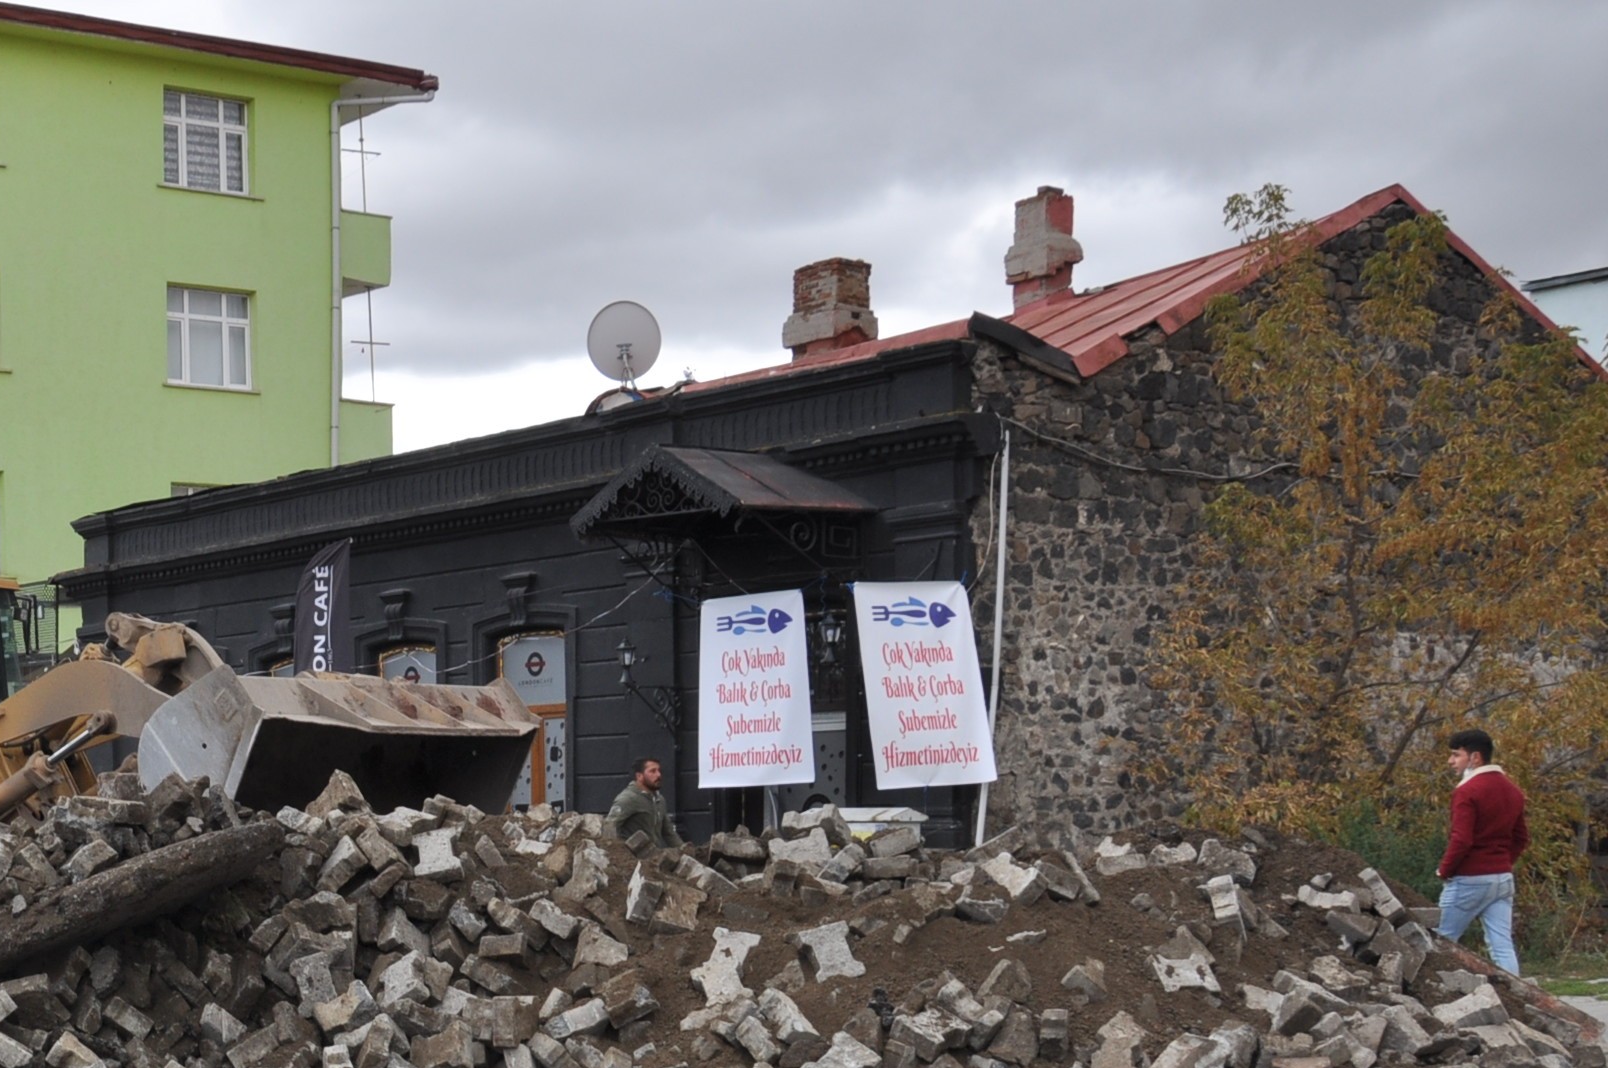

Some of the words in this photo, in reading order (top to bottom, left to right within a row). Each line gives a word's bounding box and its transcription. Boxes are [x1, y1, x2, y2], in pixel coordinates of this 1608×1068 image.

[311, 564, 329, 627] CAFÉ
[721, 649, 743, 678] Çok
[742, 645, 786, 676] Yakında
[882, 641, 904, 671] Çok
[903, 639, 954, 670] Yakında
[716, 681, 749, 706] Balık
[749, 680, 759, 702] &
[761, 677, 791, 707] Çorba
[881, 674, 919, 702] Balık
[917, 675, 927, 697] &
[929, 673, 965, 703] Çorba
[726, 710, 782, 741] Şubemizle
[898, 707, 959, 738] Şubemizle
[709, 742, 803, 773] Hizmetinizdeyiz
[882, 740, 980, 773] Hizmetinizdeyiz
